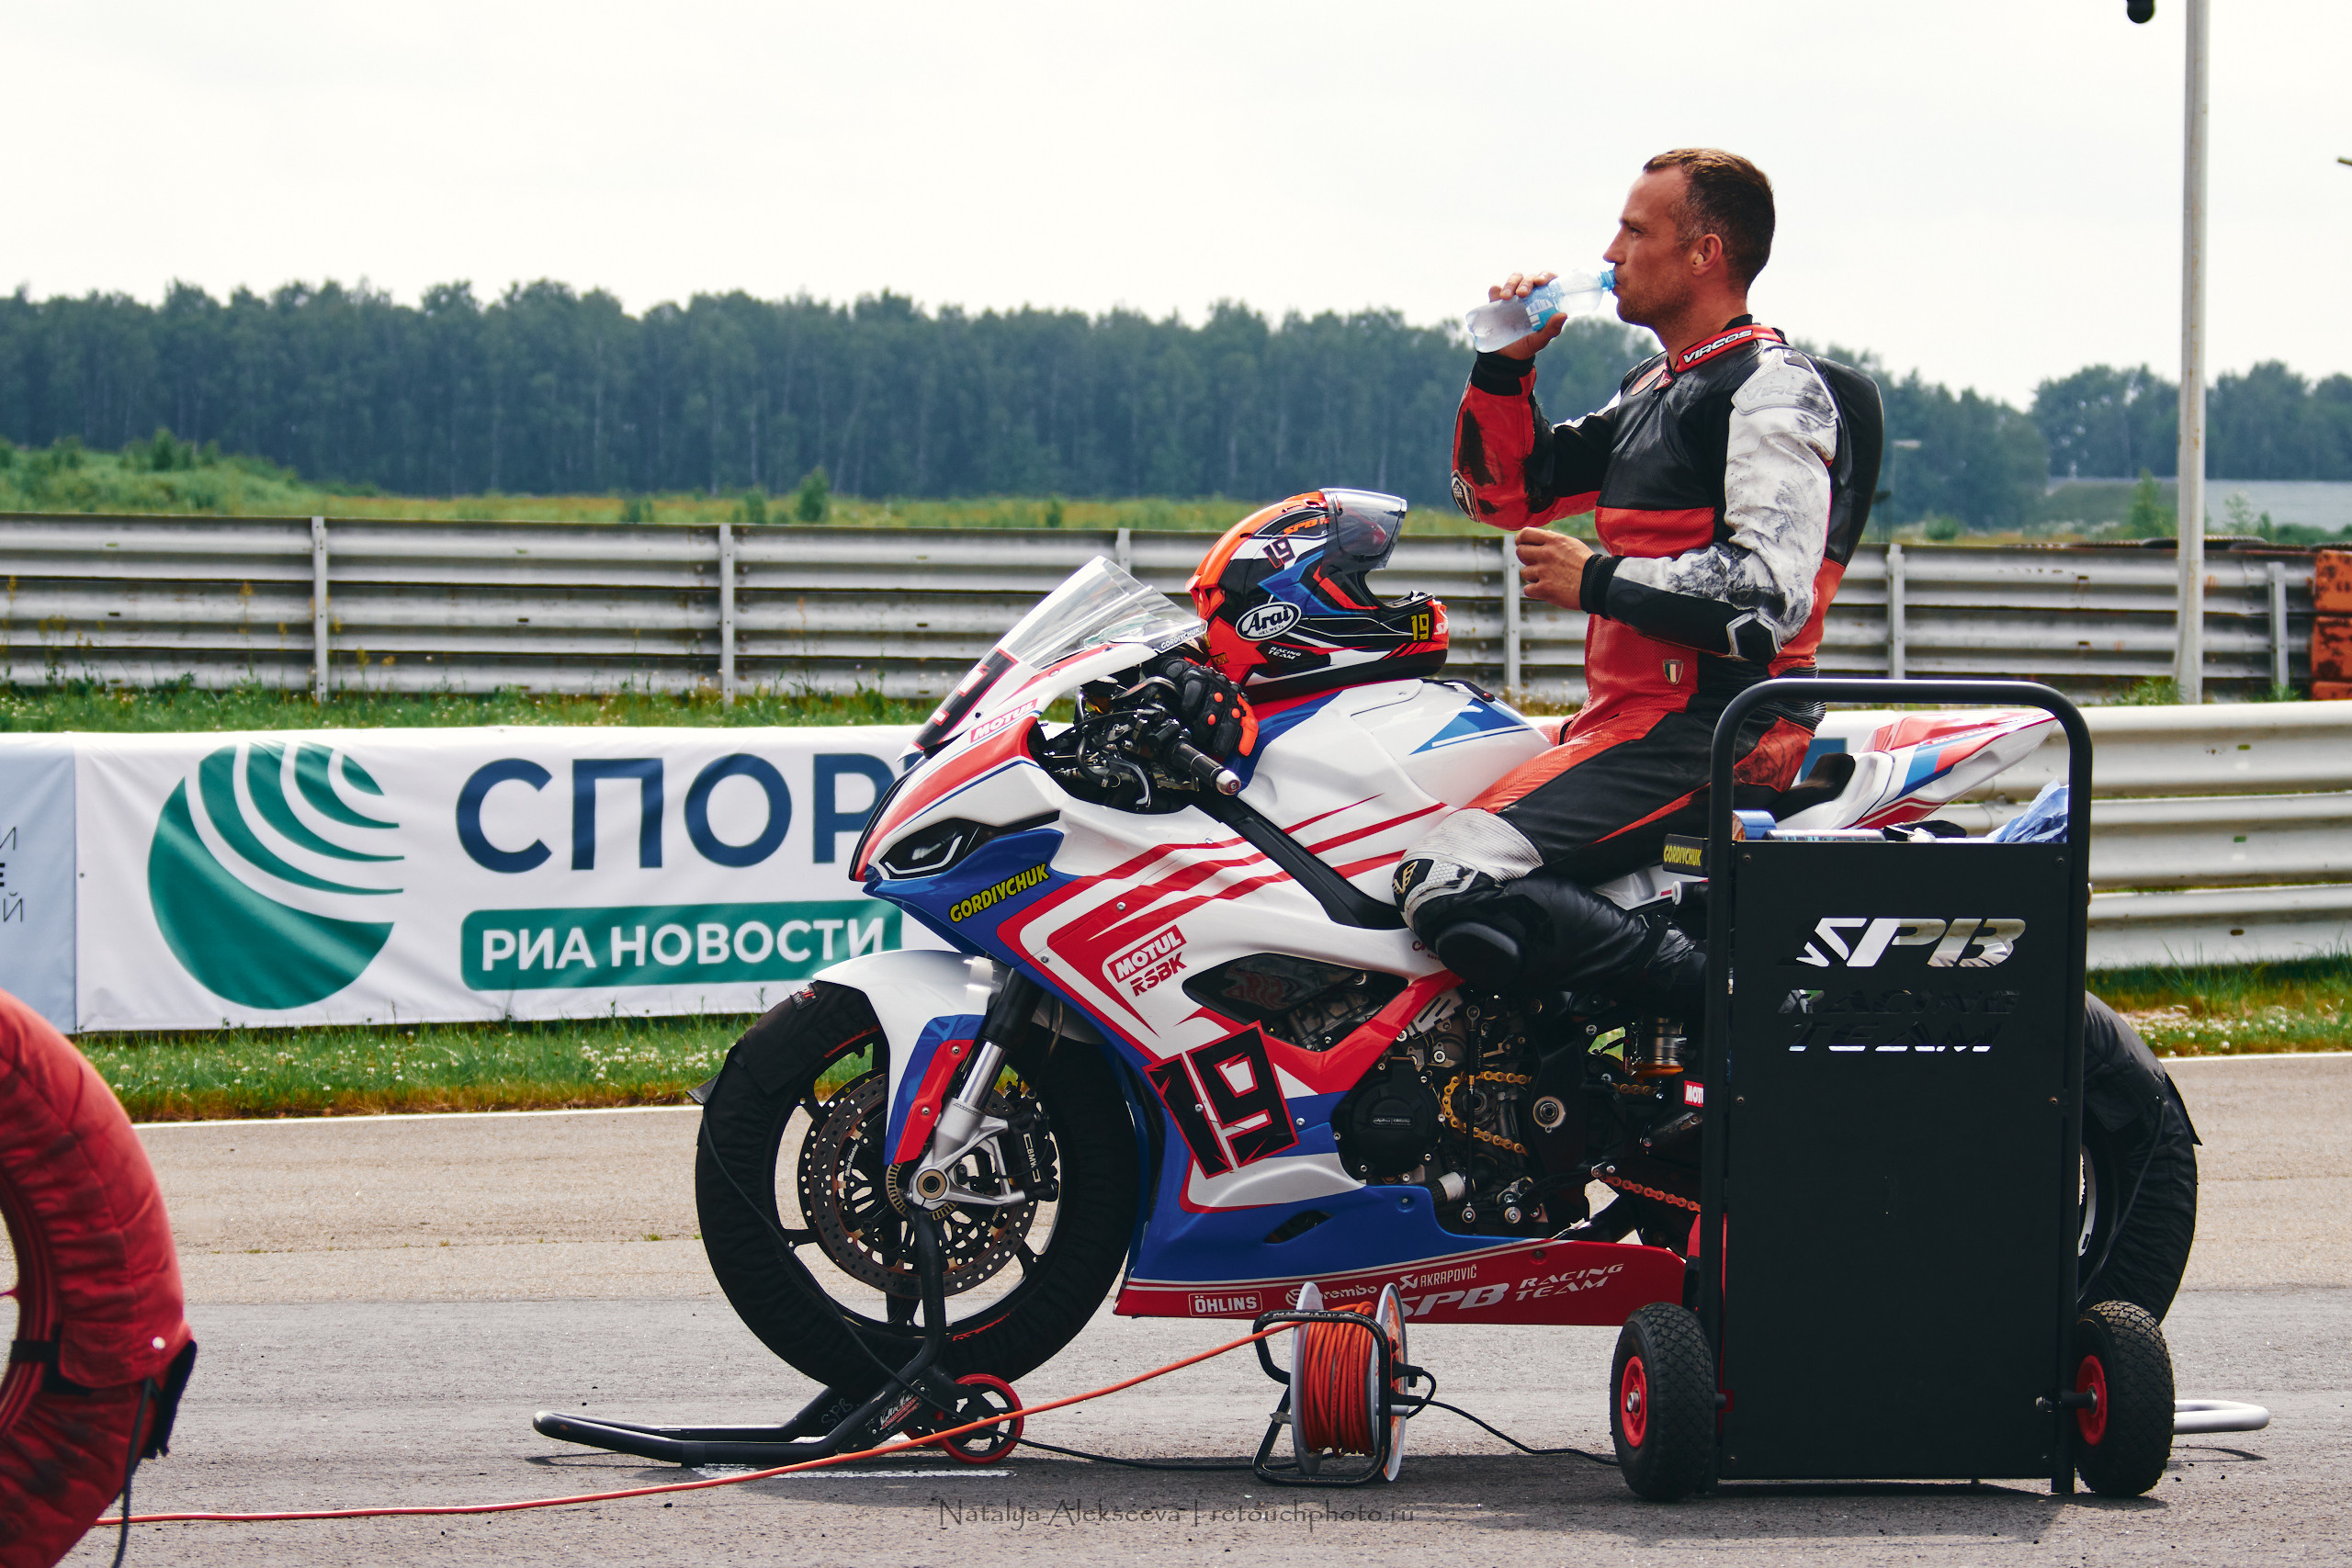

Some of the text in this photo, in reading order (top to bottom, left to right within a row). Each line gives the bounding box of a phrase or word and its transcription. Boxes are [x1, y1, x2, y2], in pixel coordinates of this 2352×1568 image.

[1682, 327, 1753, 365] VIRCOS
[1261, 536, 1296, 569] 19
[1242, 604, 1292, 635] Arai
[1410, 613, 1430, 641] 19
[1160, 626, 1201, 649] GORDIYCHUK
[1271, 646, 1301, 657] RACING
[1268, 649, 1295, 660] TEAM
[972, 701, 1036, 739] MOTUL
[456, 752, 919, 874] СПОР
[1663, 844, 1702, 868] GORDIYCHUK
[949, 863, 1051, 923] GORDIYCHUK
[481, 917, 885, 973] РИА НОВОСТИ
[1114, 931, 1182, 981] MOTUL
[1130, 952, 1188, 998] RSBK
[1778, 988, 2021, 1014] RACING
[1788, 1021, 2005, 1053] TEAM
[1142, 1020, 1301, 1180] 19
[1026, 1147, 1037, 1168] BMW
[1420, 1264, 1477, 1288] AKRAPOVIČ
[1515, 1276, 1610, 1302] TEAM
[1519, 1263, 1624, 1289] RACING
[1194, 1295, 1258, 1314] ÖHLINS
[1319, 1284, 1378, 1301] rembo
[1400, 1282, 1510, 1317] SPB
